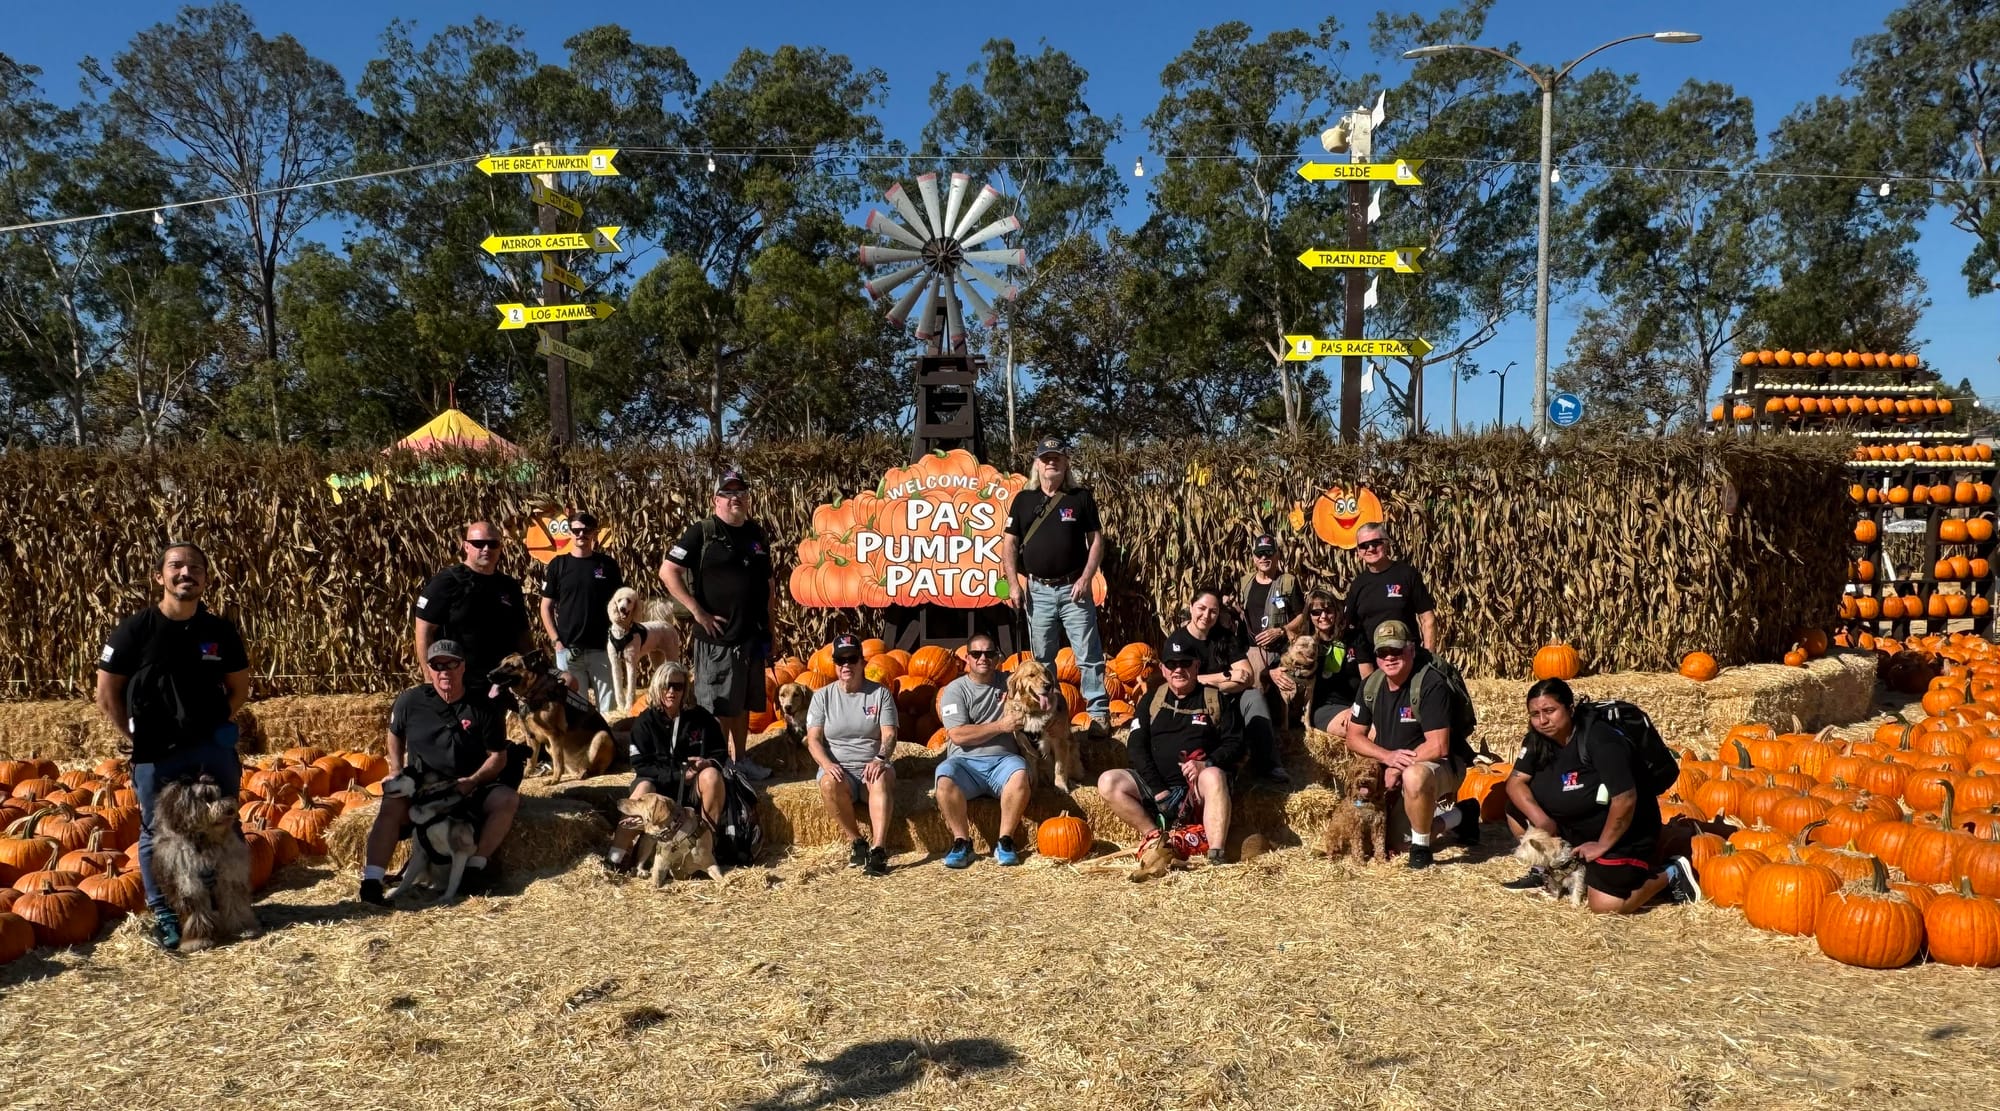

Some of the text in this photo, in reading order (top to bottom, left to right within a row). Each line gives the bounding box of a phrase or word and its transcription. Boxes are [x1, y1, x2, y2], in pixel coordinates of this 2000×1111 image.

[490, 156, 603, 170] THE GREAT PUMPKIN 1
[1334, 166, 1371, 177] SLIDE
[501, 239, 542, 250] MIRROR
[545, 236, 584, 247] CASTLE
[1319, 254, 1355, 265] TRAIN
[1359, 254, 1386, 265] RIDE
[513, 307, 597, 320] 2 LOG JAMMER
[1320, 343, 1343, 353] PA'S
[1347, 343, 1374, 353] RACE
[1379, 343, 1412, 353] TRACK
[887, 474, 1009, 501] WELCOME TO
[906, 498, 995, 532] PA'S
[855, 531, 1002, 564] PUMPK
